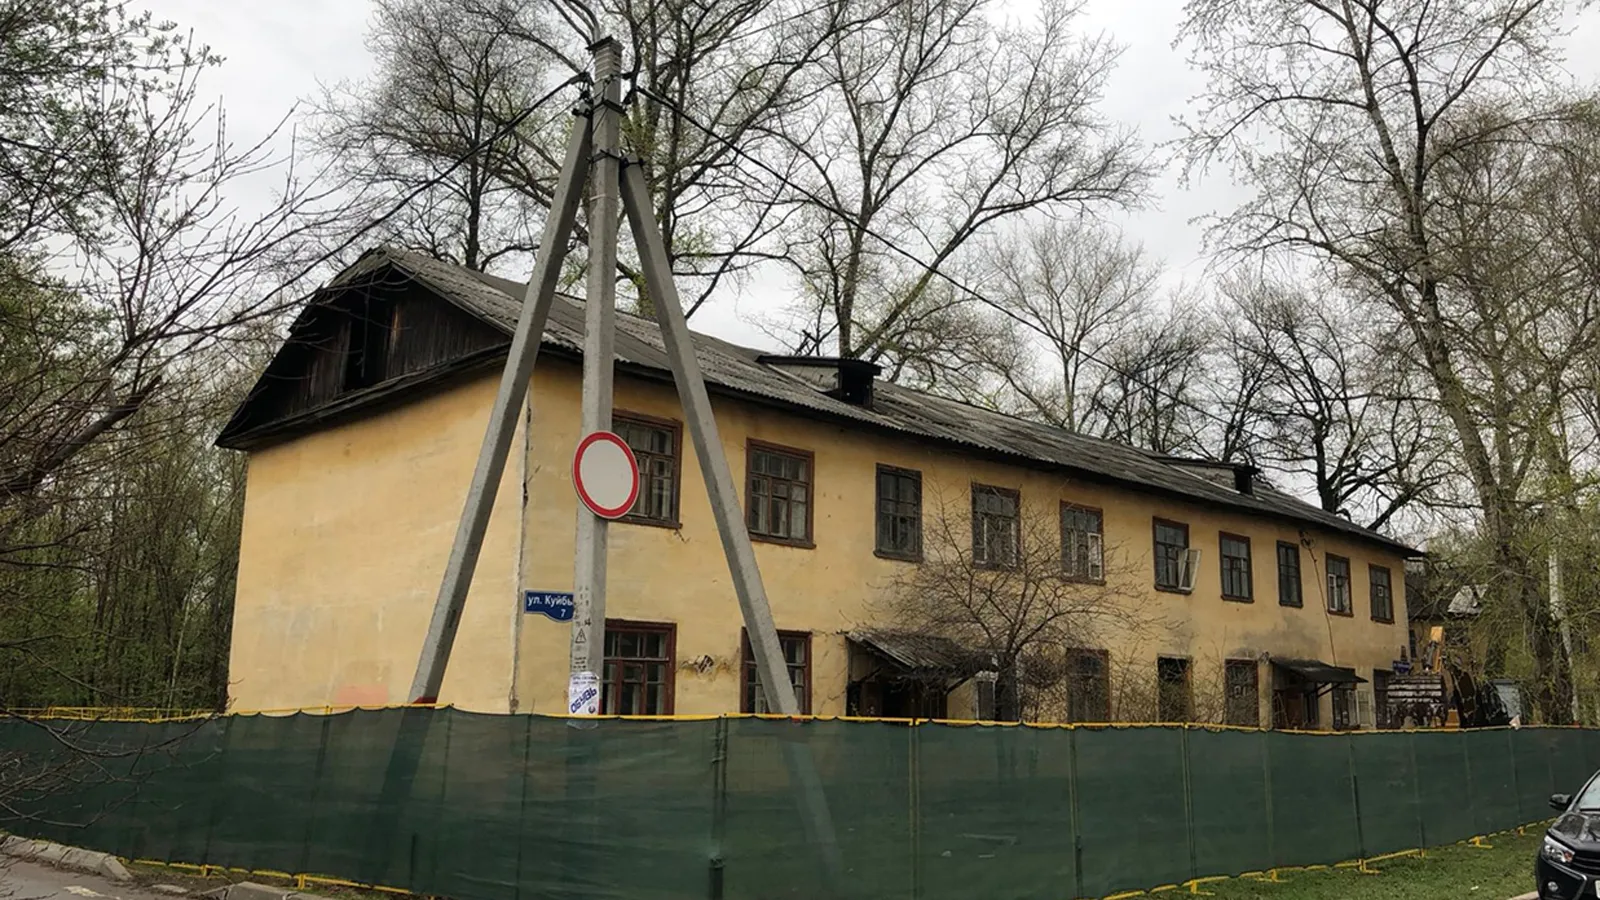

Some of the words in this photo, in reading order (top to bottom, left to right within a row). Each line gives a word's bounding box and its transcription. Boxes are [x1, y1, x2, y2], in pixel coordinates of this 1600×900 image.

[527, 595, 543, 607] ул.
[560, 608, 567, 618] 7
[570, 687, 597, 714] ОБУВЬ
